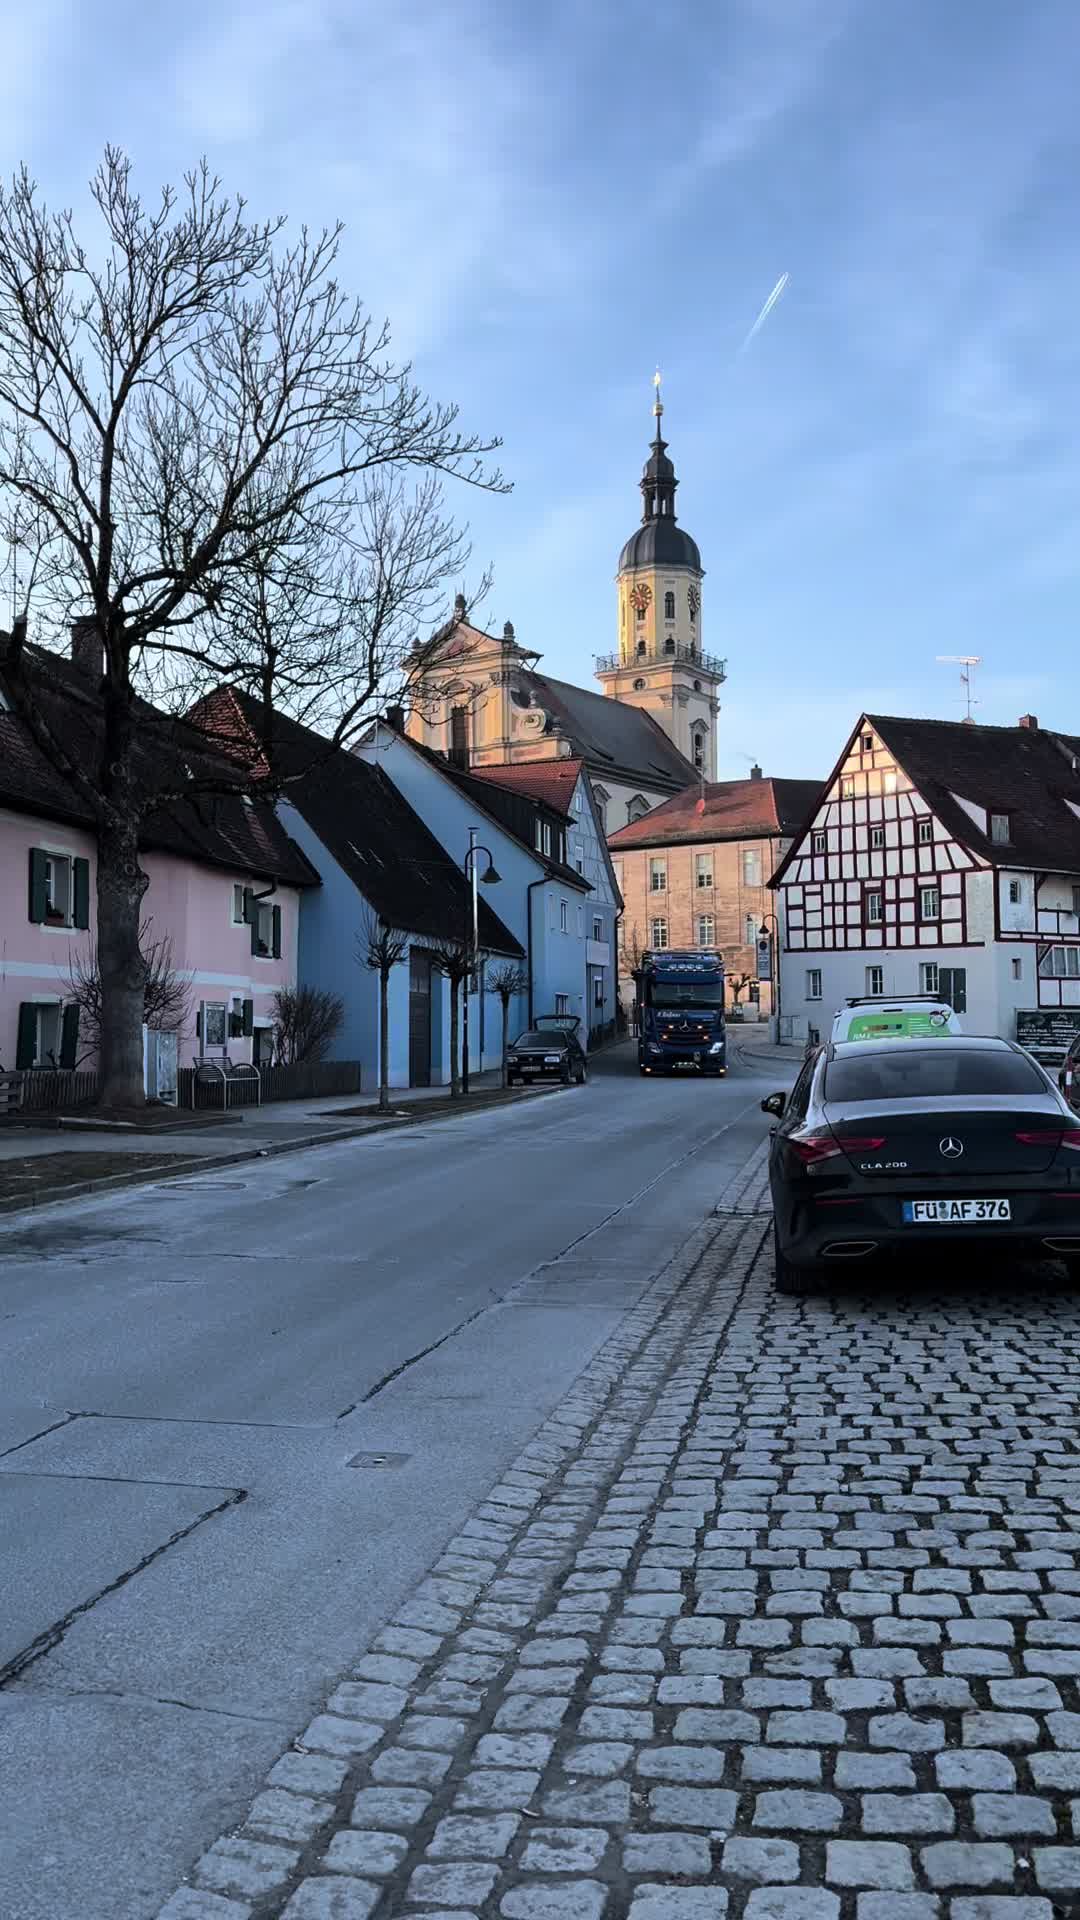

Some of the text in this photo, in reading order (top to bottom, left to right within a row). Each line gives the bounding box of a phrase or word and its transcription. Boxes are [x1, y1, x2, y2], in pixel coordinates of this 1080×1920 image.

[914, 1201, 1009, 1219] FÜ AF 376
